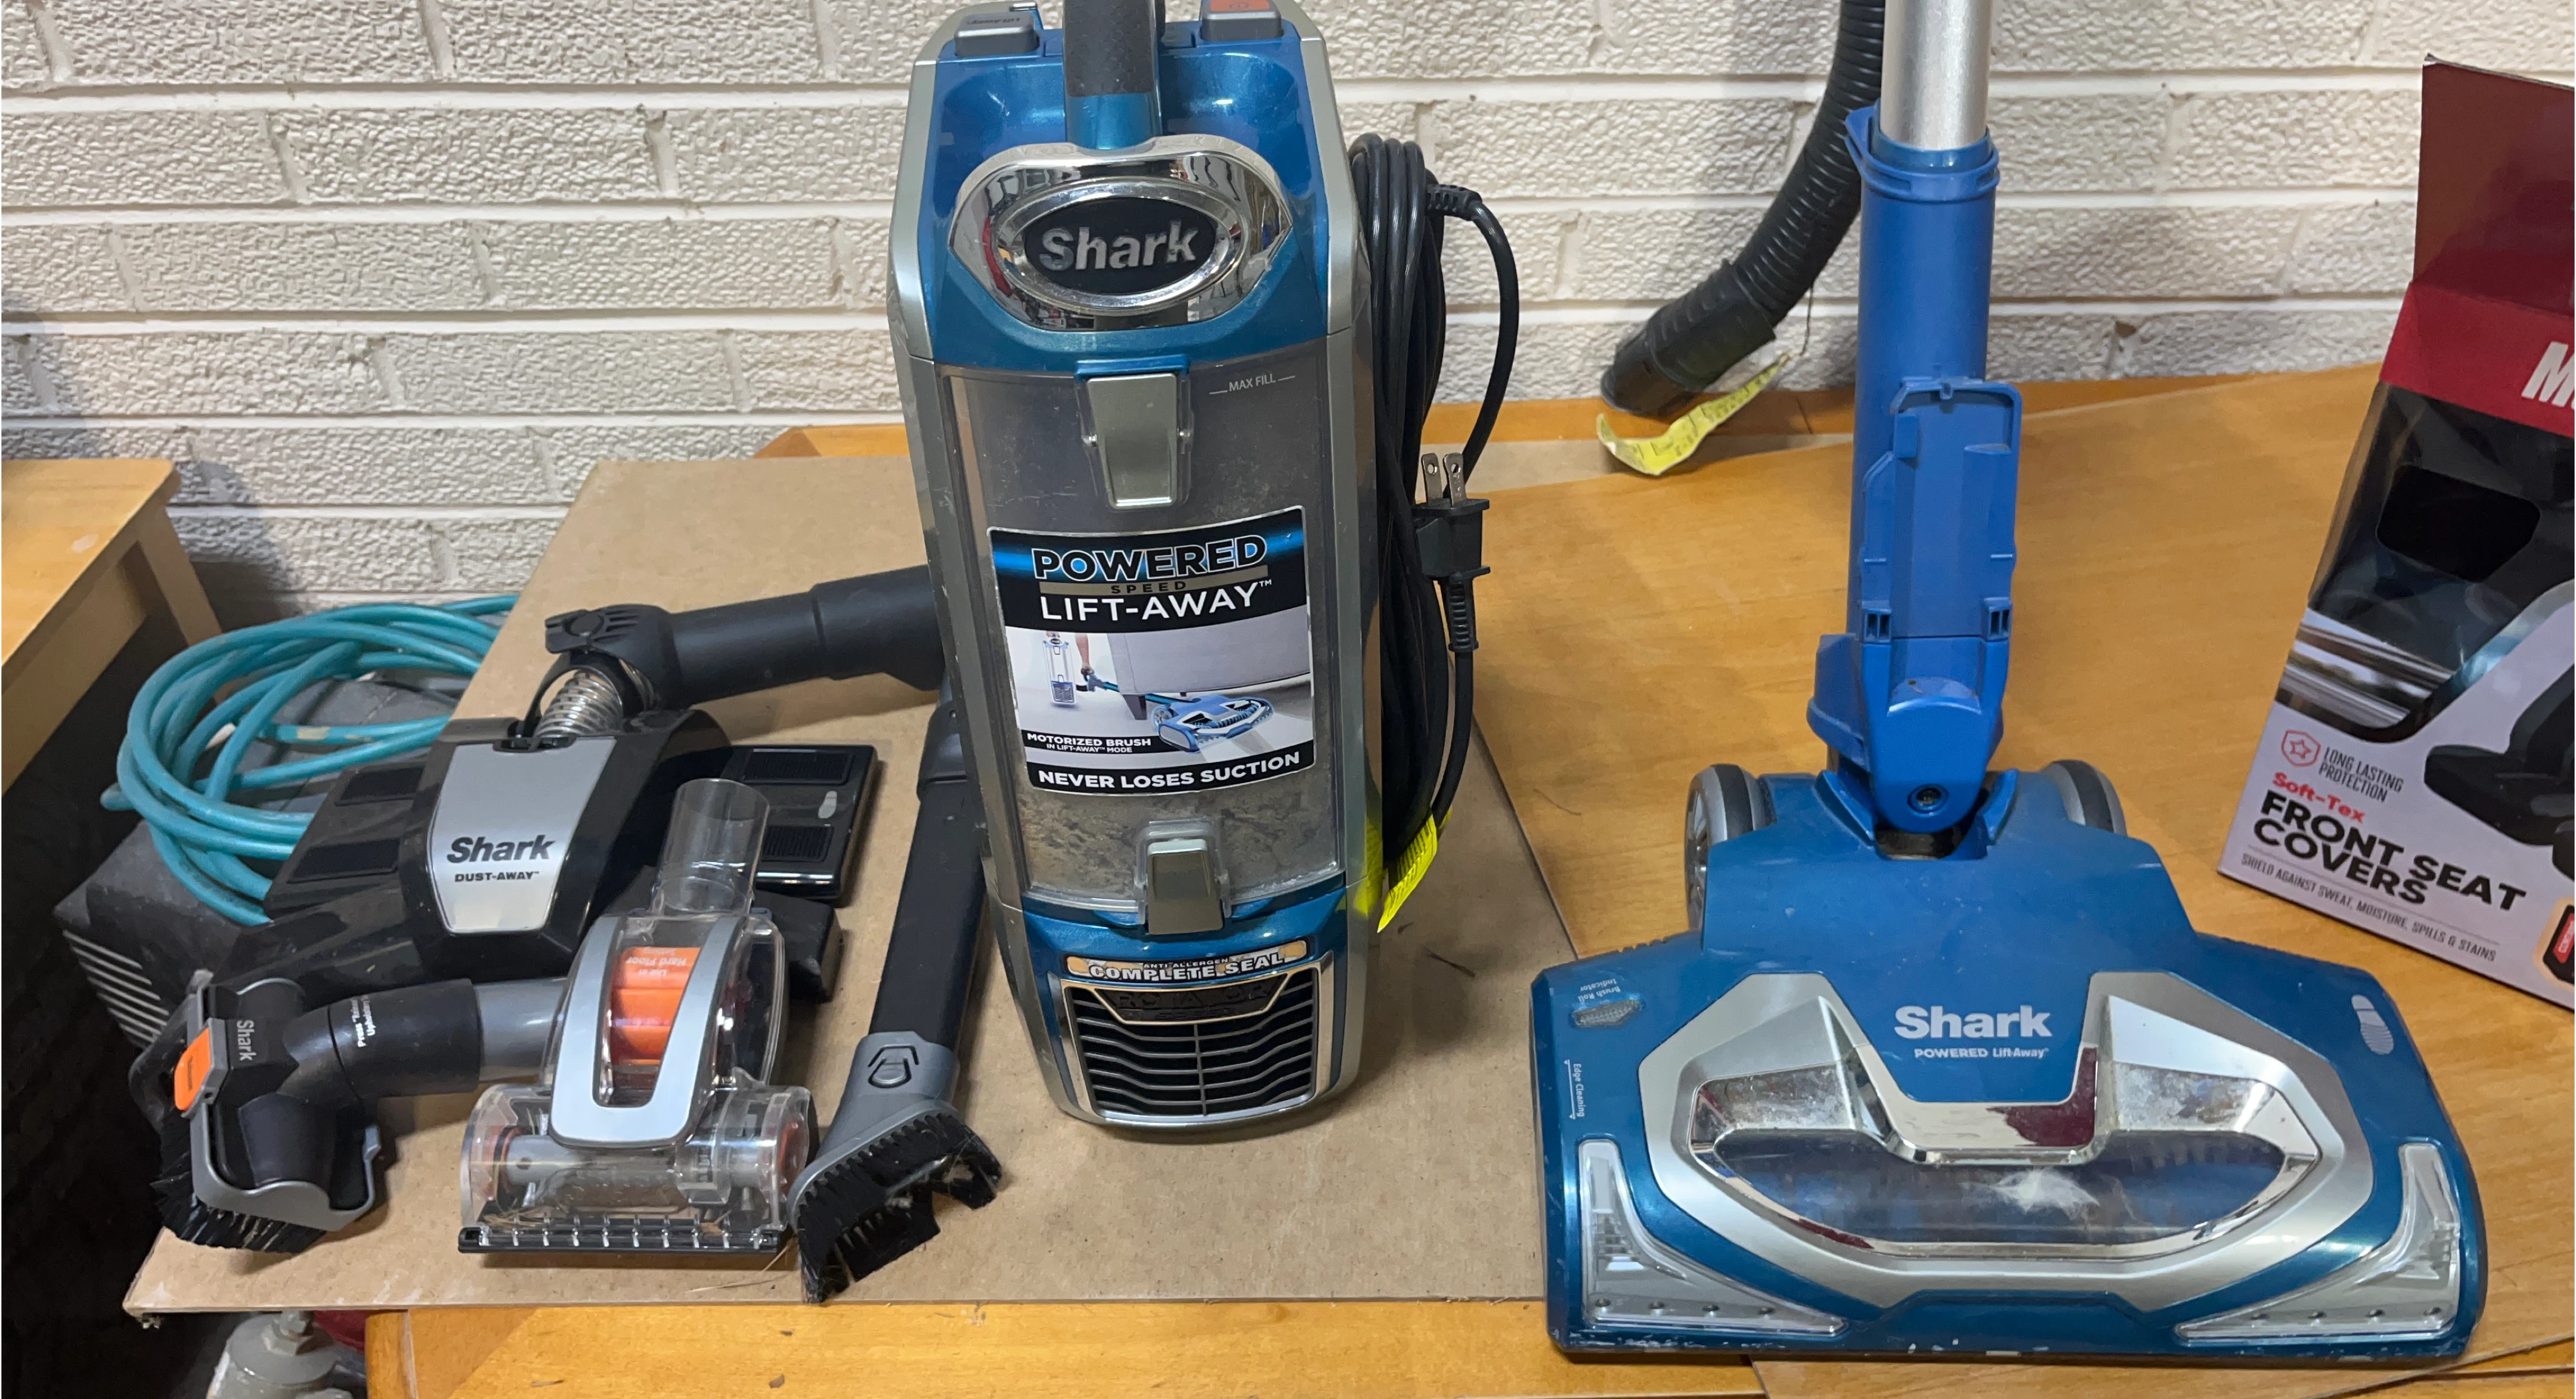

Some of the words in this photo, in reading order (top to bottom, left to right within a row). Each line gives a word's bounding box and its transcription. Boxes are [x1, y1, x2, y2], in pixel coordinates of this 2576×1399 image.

[1039, 219, 1197, 271] Shark
[1229, 379, 1252, 392] MAX
[1254, 373, 1276, 386] FILL
[2522, 342, 2575, 409] M
[1032, 535, 1267, 581] POWERED
[1111, 581, 1187, 594] SPEED
[1027, 733, 1103, 746] MOTORIZED
[1106, 738, 1151, 747] BRUSH
[1038, 770, 1114, 789] NEVER
[1121, 772, 1194, 789] LOSES
[1200, 751, 1300, 782] SUCTION
[2319, 763, 2388, 803] PROTECTION
[2325, 747, 2353, 770] LONG
[2355, 758, 2404, 793] LASTING
[2272, 772, 2366, 824] Soft-Tex
[447, 834, 556, 863] Shark
[2253, 819, 2426, 905] COVERS
[2261, 790, 2404, 866] FRONT
[2408, 855, 2527, 911] SEAT
[2241, 853, 2274, 876] SHIELD
[2275, 868, 2317, 892] AGAINST
[2412, 921, 2445, 943] SPILLS
[2458, 939, 2497, 961] STAINS
[1089, 964, 1214, 981] COMPLETE
[1225, 954, 1284, 974] SEAL
[1144, 958, 1228, 968] ANTIALLERGEN
[1578, 993, 1594, 1002] Roll
[1580, 979, 1617, 991] Indicator
[1596, 986, 1621, 997] Brush
[1894, 1005, 2052, 1039] Shark
[237, 1020, 256, 1061] Shark
[1914, 1048, 1988, 1058] POWERED
[1572, 1063, 1582, 1082] Edge
[1576, 1084, 1586, 1117] Cleaning
